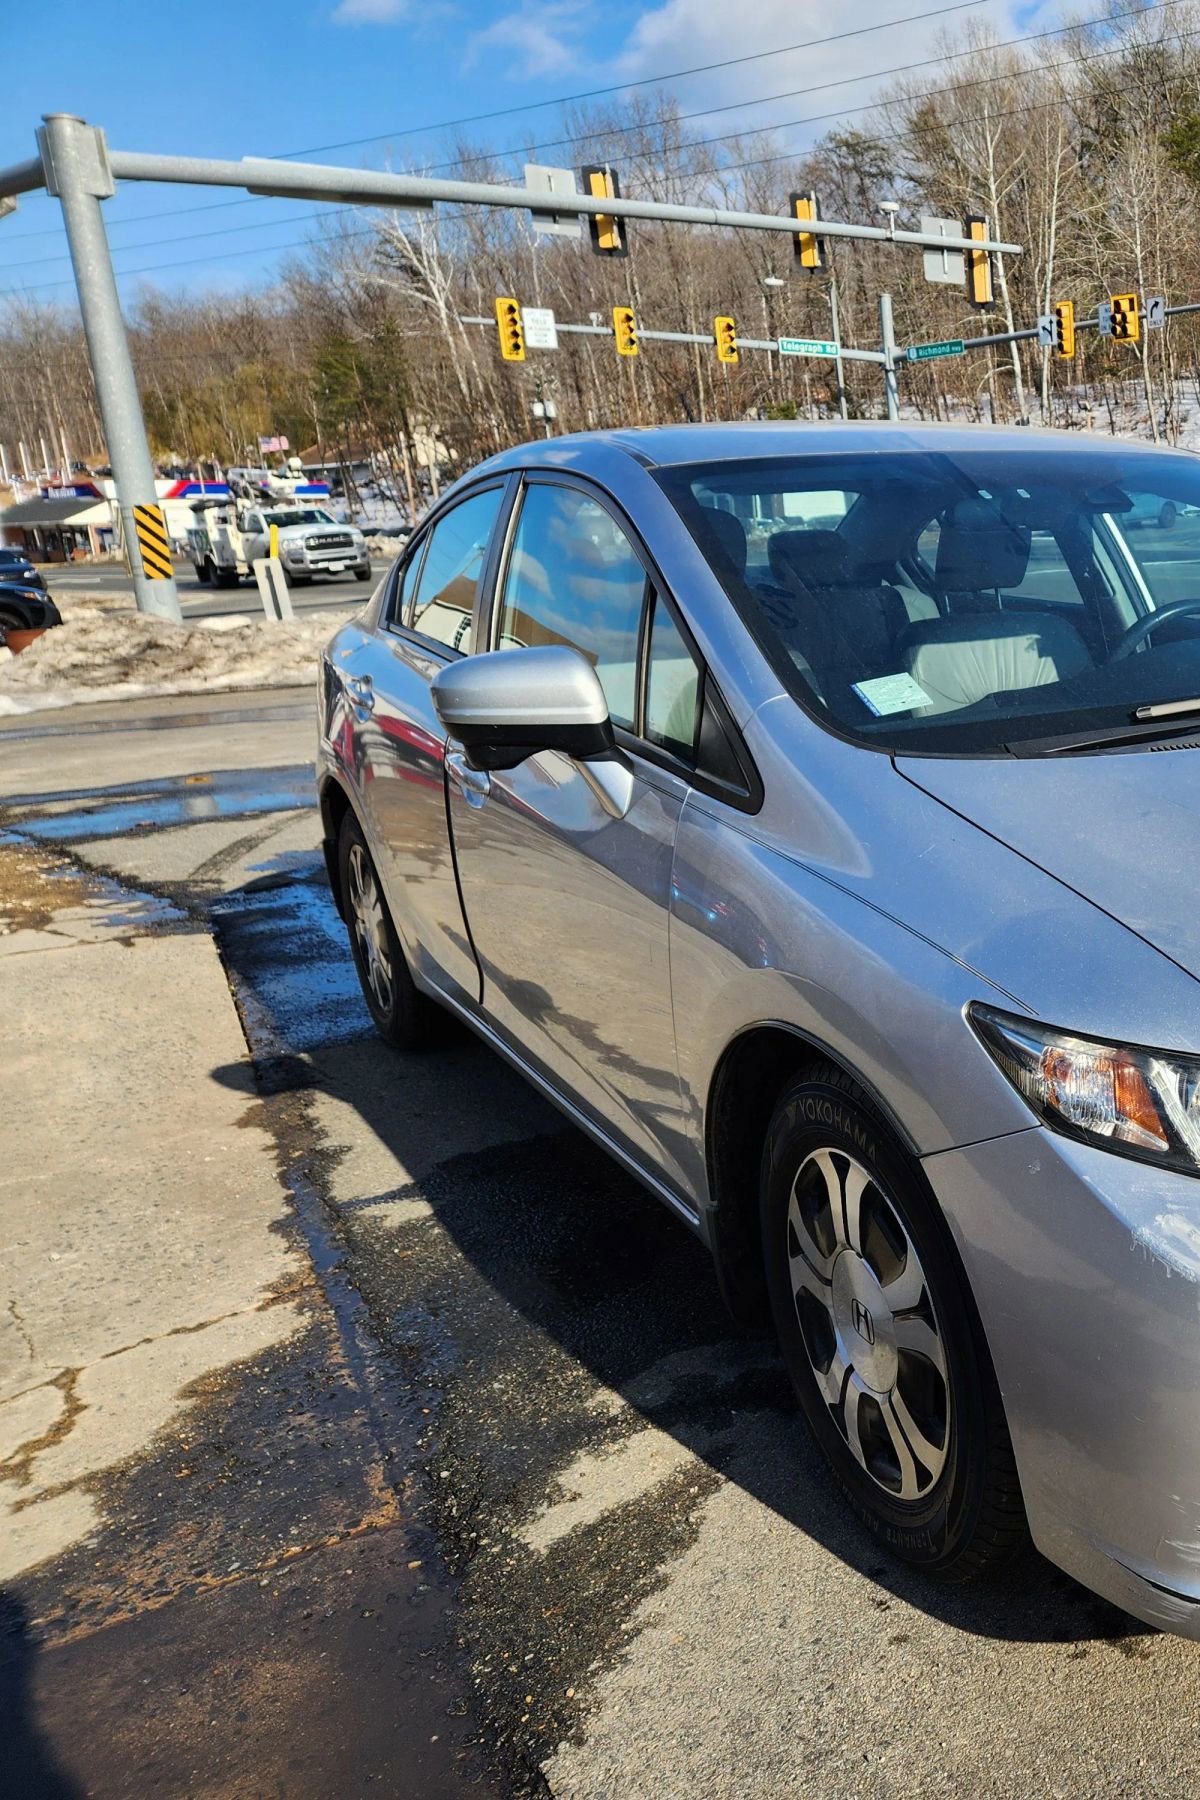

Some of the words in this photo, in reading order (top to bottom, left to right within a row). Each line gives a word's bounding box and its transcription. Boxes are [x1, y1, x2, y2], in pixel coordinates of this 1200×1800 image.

[782, 341, 822, 354] Telegraph
[825, 343, 837, 355] Rd
[918, 344, 950, 357] Richmond
[798, 1097, 876, 1162] YOKOHAMA
